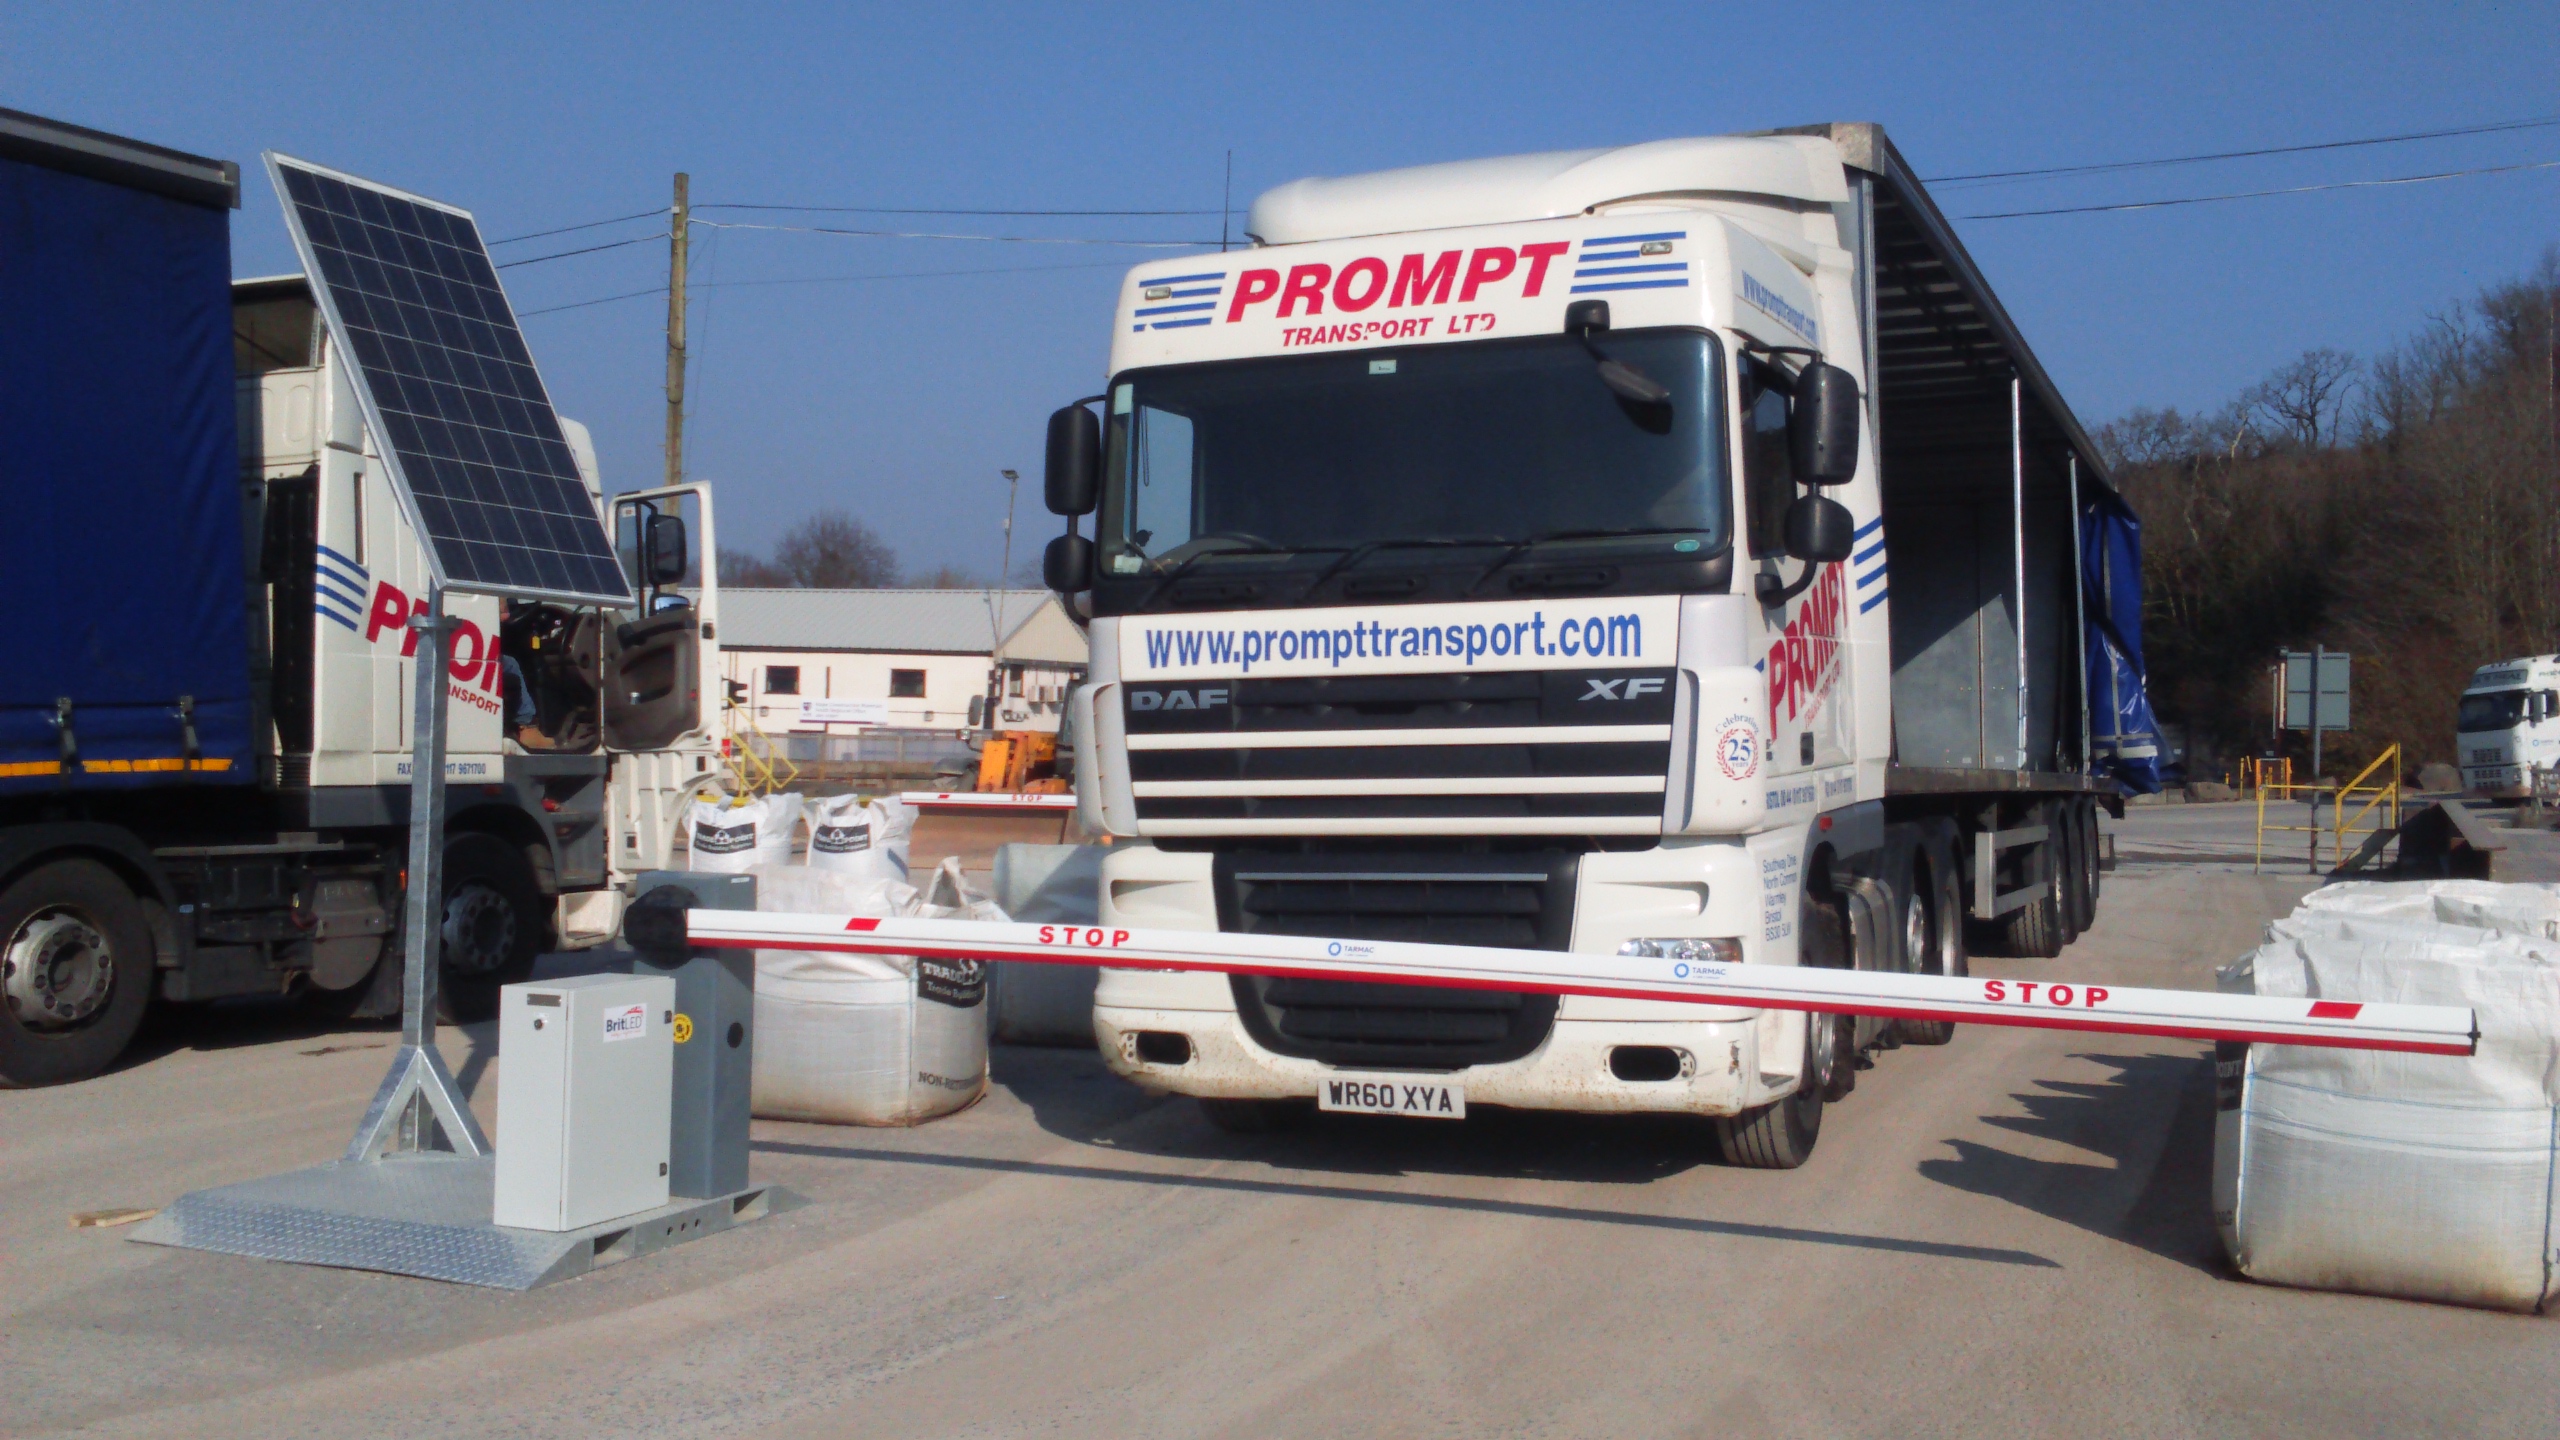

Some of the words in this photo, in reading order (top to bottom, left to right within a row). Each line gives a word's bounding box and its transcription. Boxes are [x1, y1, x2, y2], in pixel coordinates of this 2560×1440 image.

[1226, 241, 1570, 323] PROMPT
[1283, 317, 1433, 347] TRANSPORT
[1447, 312, 1496, 335] LTD
[1146, 612, 1641, 672] www.prompttransport.com
[448, 684, 501, 715] NSPORT
[1131, 688, 1228, 711] DAF
[1578, 678, 1665, 701] XF
[1728, 738, 1751, 761] 25
[1012, 793, 1042, 802] STOP
[1039, 926, 1130, 947] STOP
[1344, 945, 1374, 953] TARMAC
[1693, 967, 1726, 975] TARMAC
[1984, 980, 2109, 1008] STOP
[606, 1016, 643, 1033] BritLED
[1329, 1081, 1395, 1109] WR60
[1403, 1085, 1453, 1113] XYA
